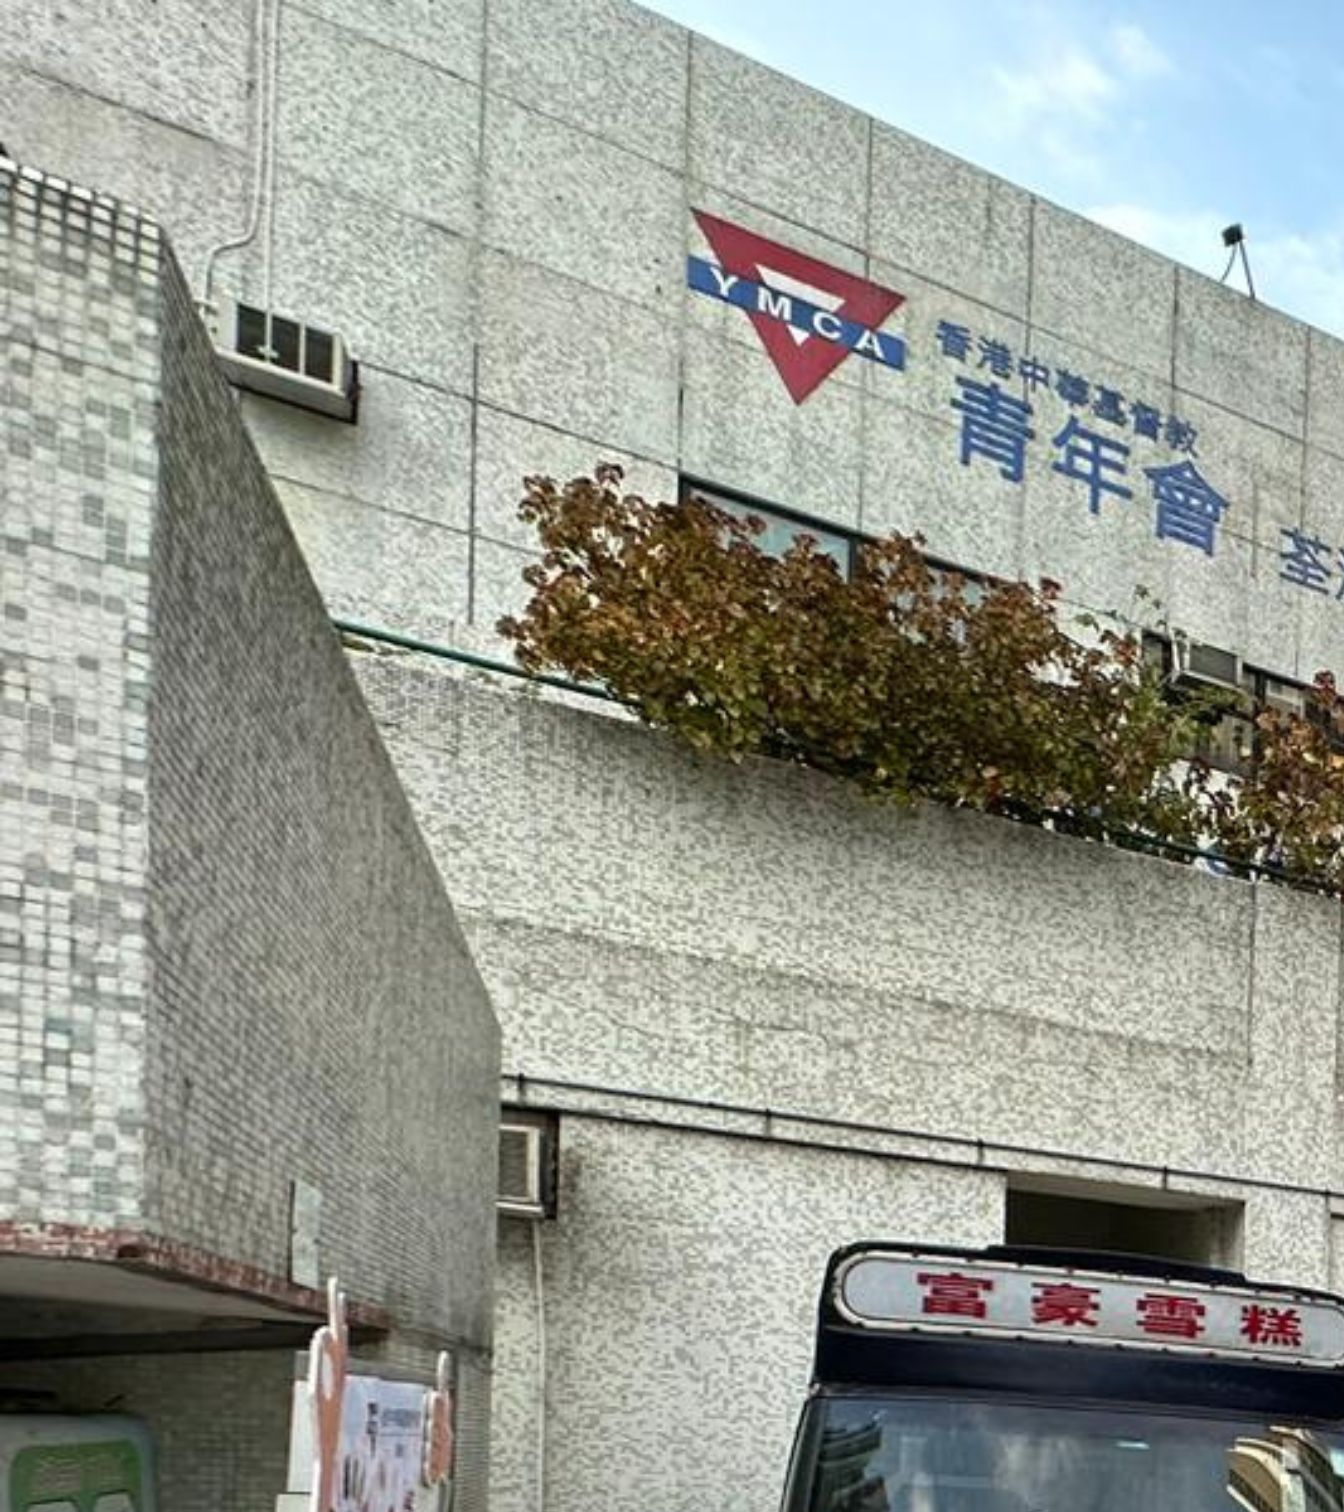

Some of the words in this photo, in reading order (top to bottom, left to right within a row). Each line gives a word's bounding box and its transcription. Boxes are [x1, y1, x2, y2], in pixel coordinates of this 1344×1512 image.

[710, 266, 885, 359] YMCA
[950, 374, 1230, 557] 青年會
[916, 1272, 1302, 1347] 富豪雪糕
